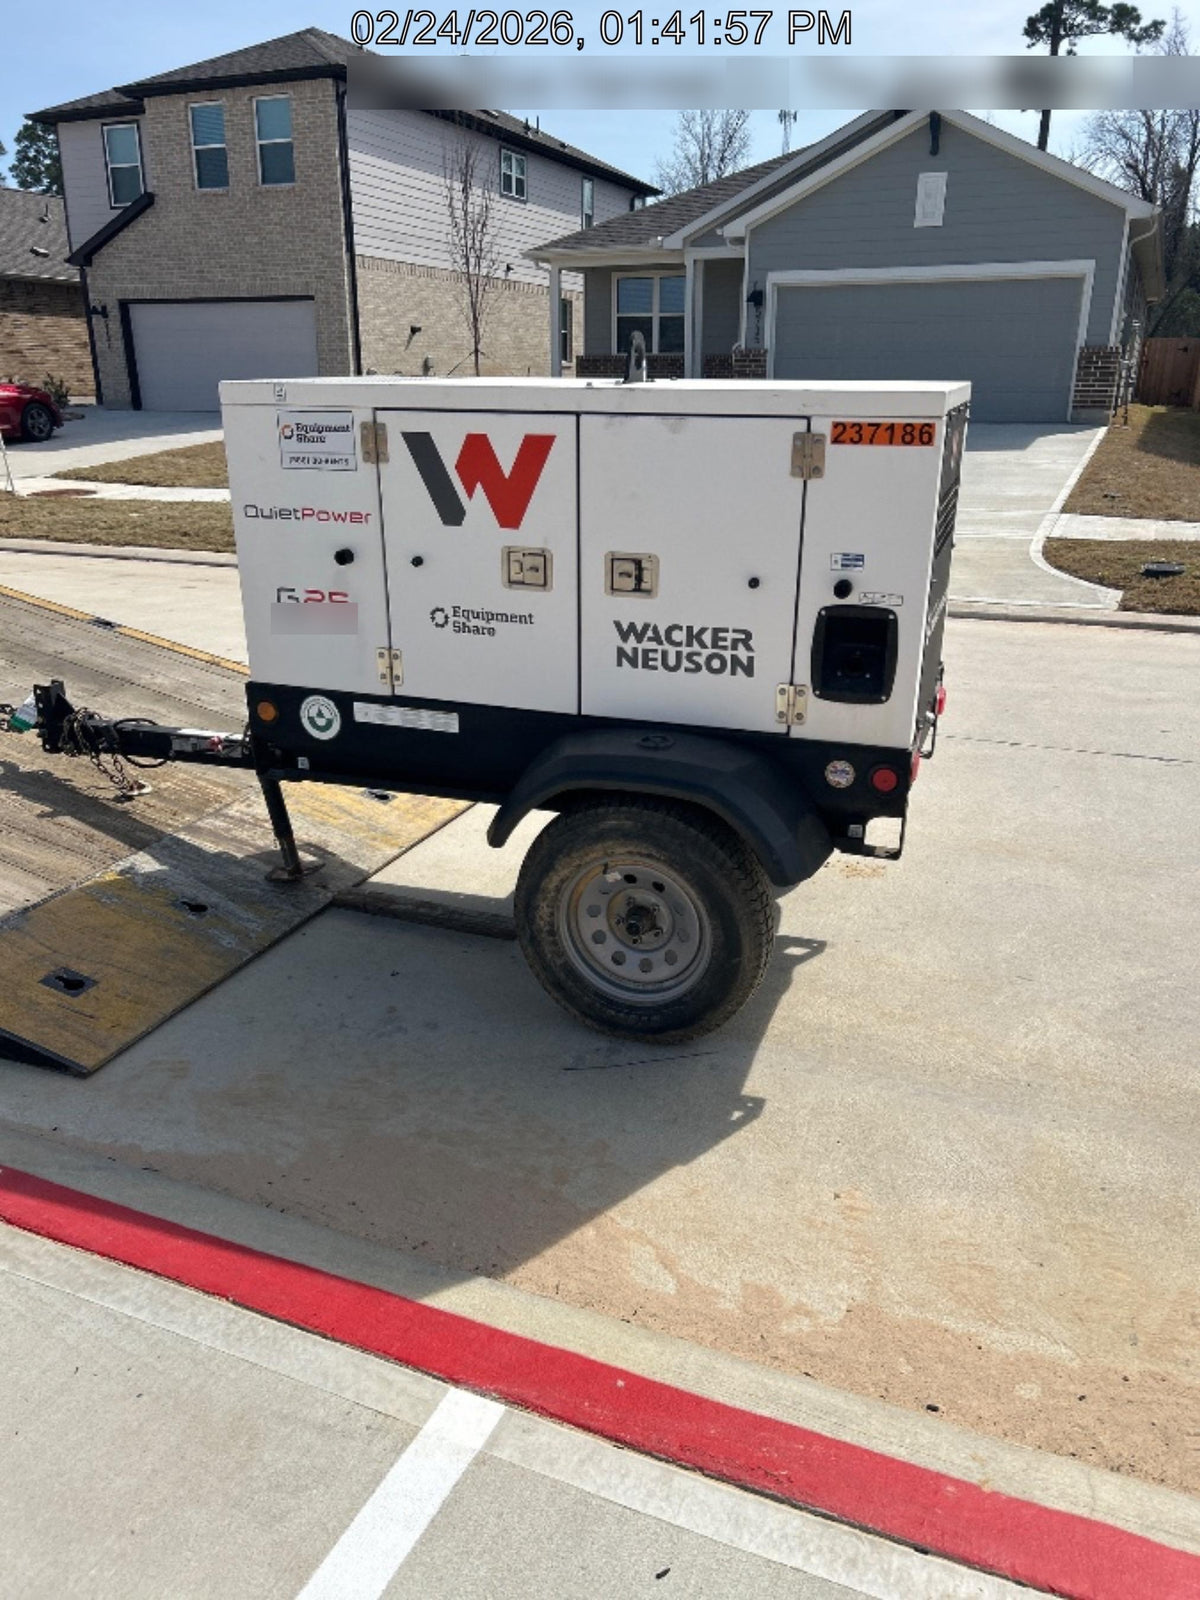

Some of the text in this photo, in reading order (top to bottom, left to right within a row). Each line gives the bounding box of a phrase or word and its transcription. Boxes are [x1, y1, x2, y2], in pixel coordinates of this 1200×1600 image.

[831, 422, 933, 445] 237186
[243, 504, 372, 524] QuietPower
[452, 605, 534, 625] Equipment
[452, 620, 496, 636] Share
[613, 620, 755, 652] WACKER
[616, 646, 755, 678] NEUSON
